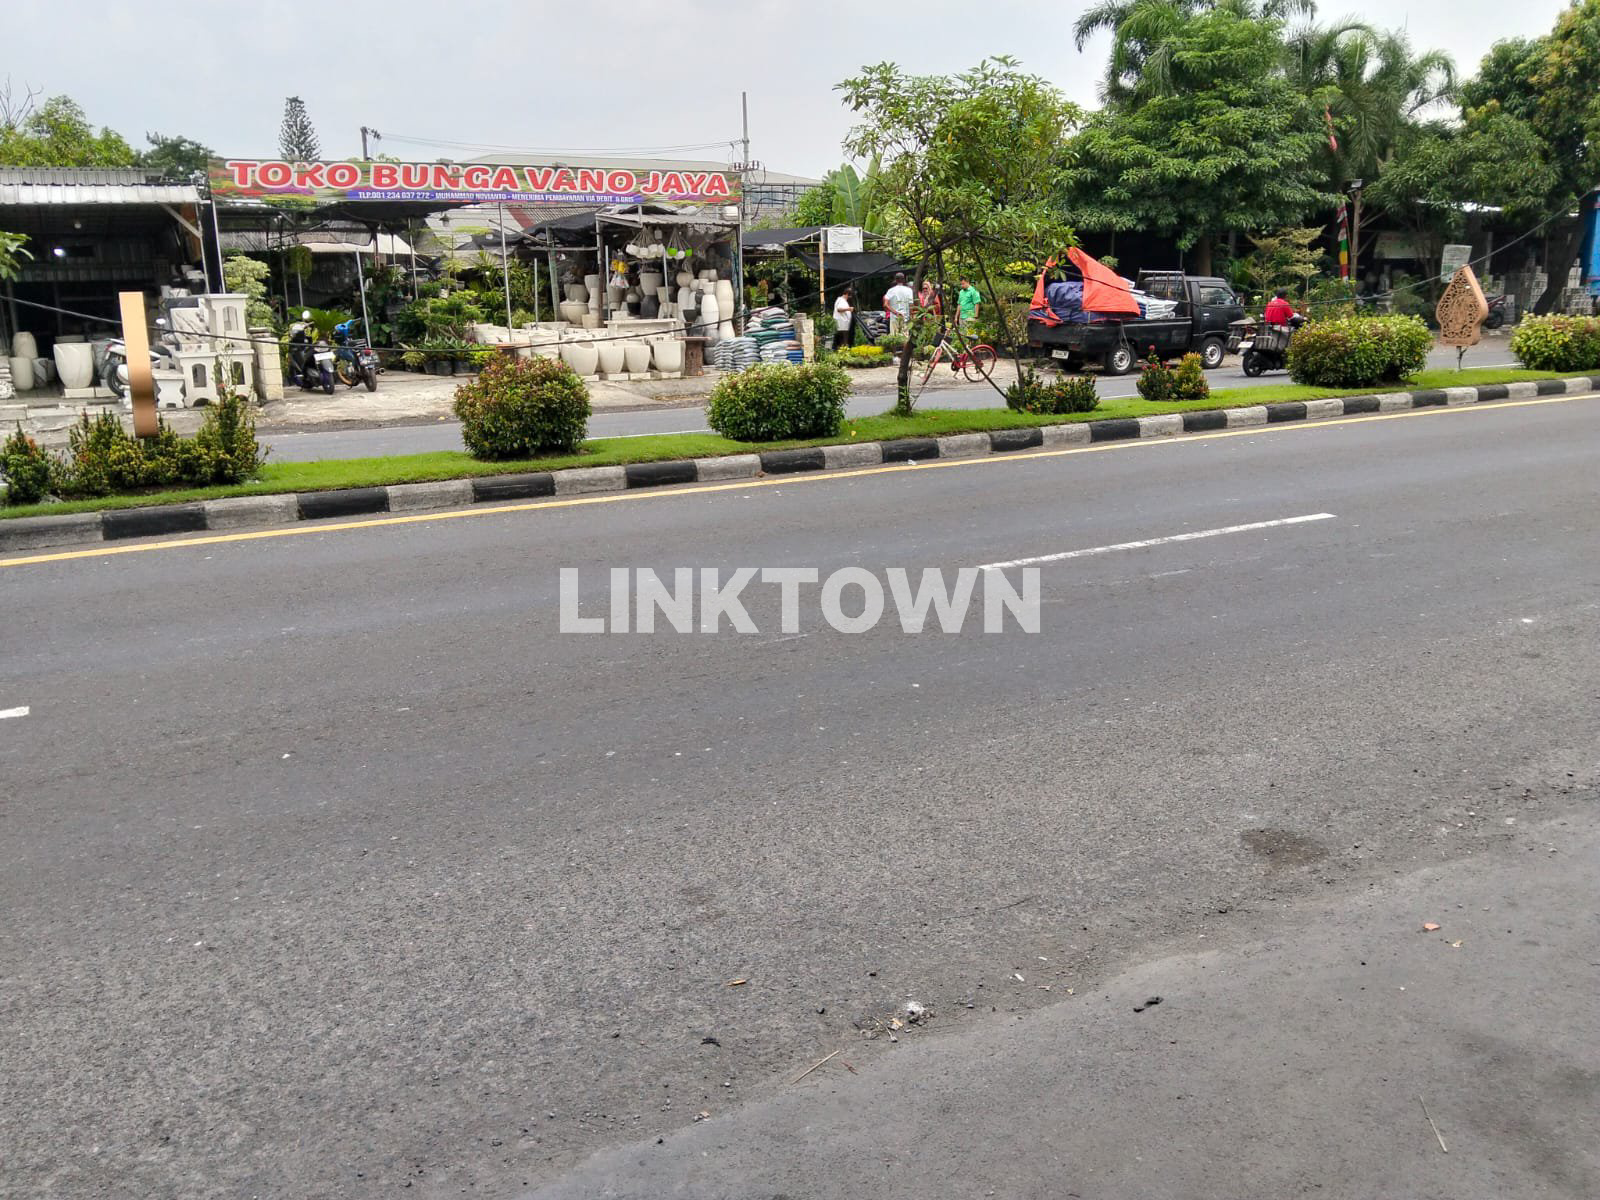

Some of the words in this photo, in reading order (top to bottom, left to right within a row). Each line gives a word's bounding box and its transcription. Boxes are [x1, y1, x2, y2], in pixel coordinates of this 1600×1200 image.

[226, 161, 361, 189] TOKO
[372, 164, 521, 191] BUNGA
[525, 167, 635, 194] VANO
[640, 171, 729, 196] JAYA
